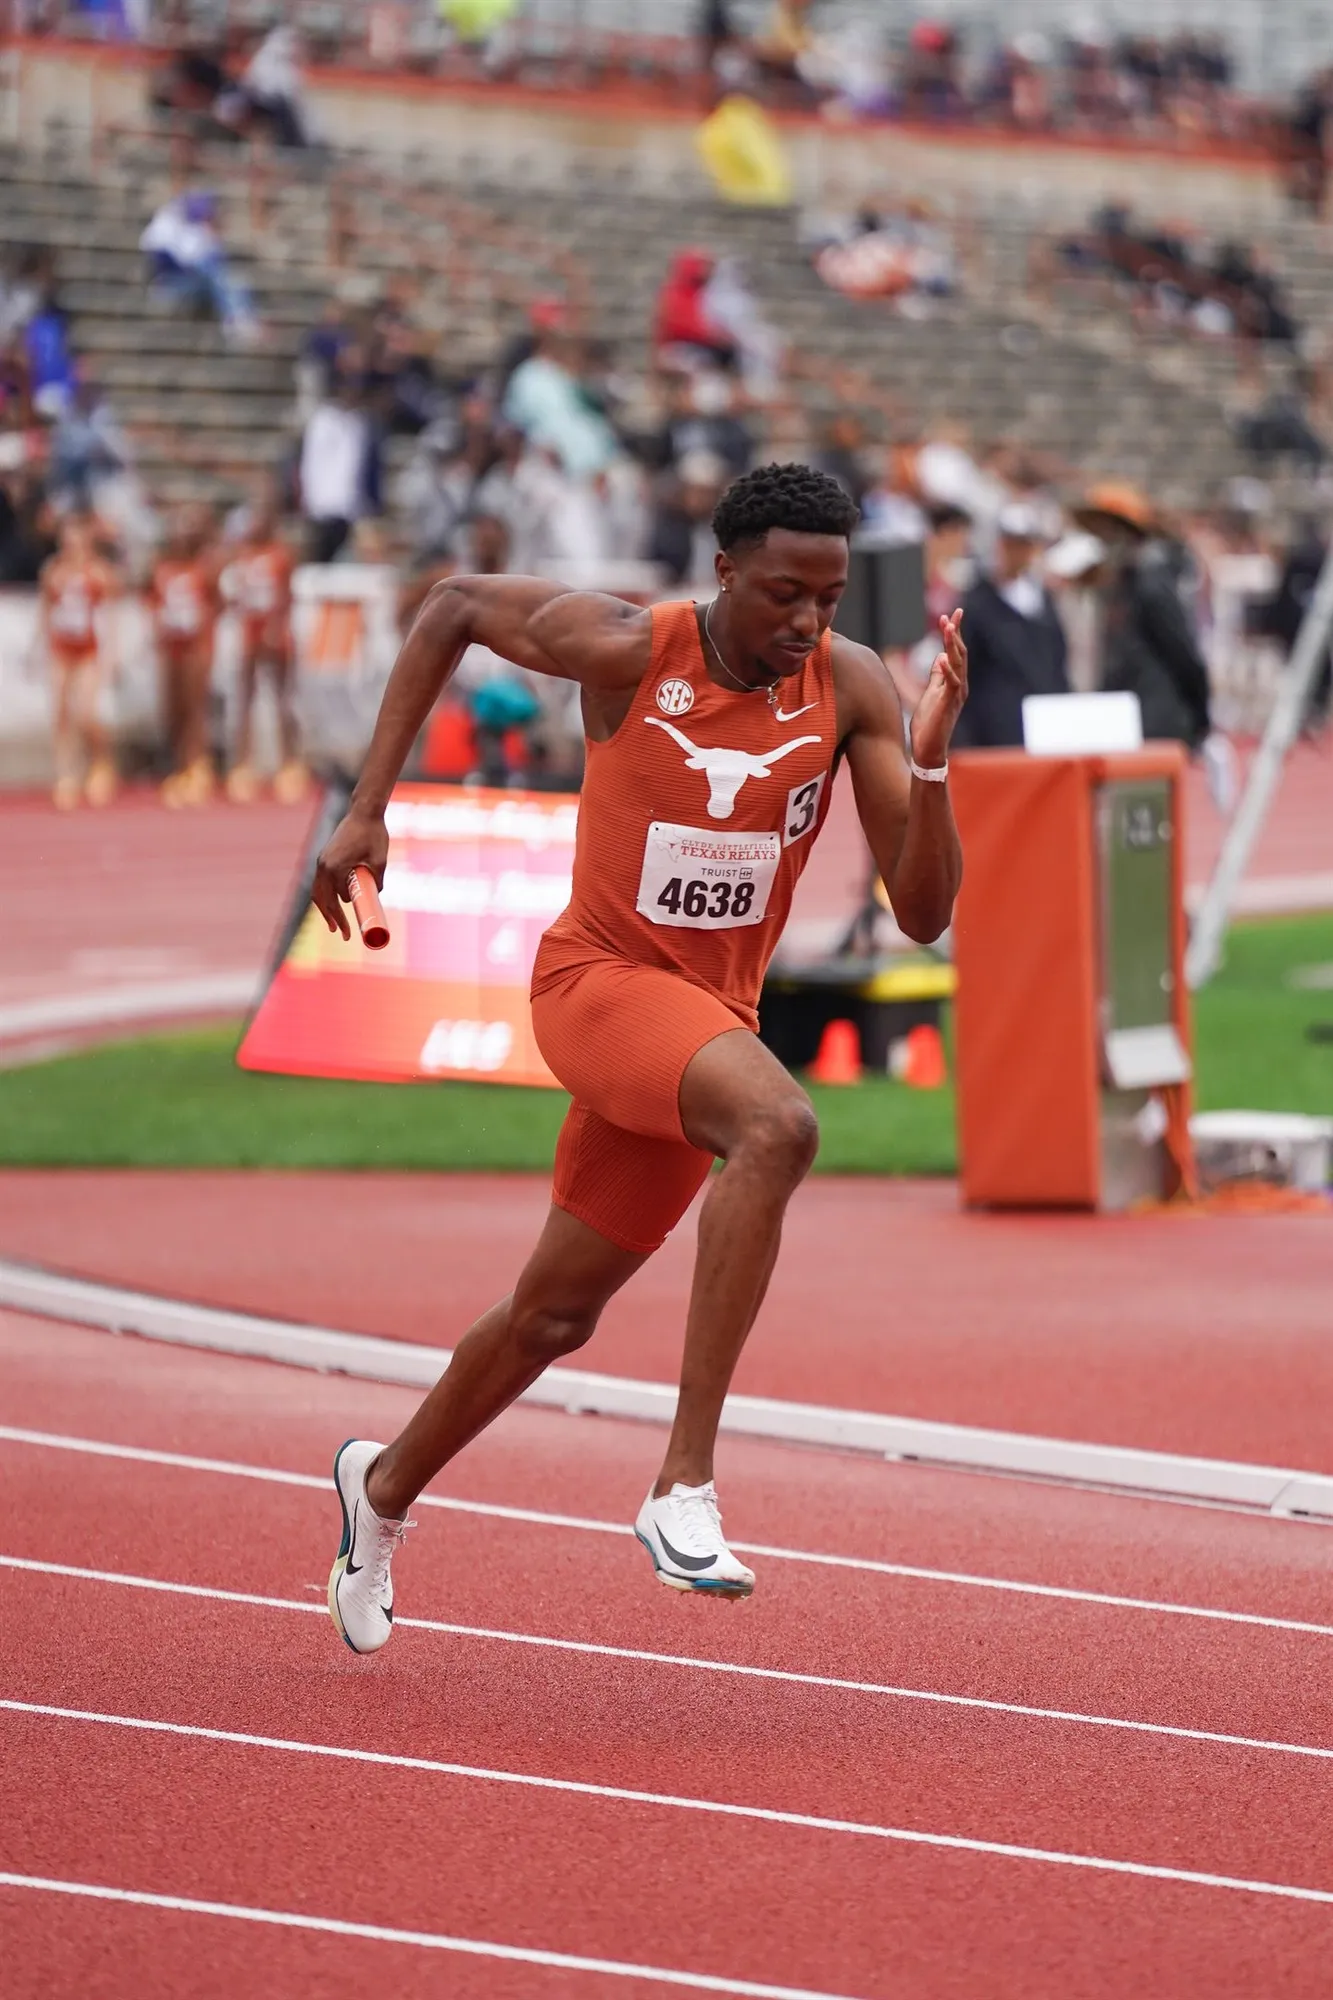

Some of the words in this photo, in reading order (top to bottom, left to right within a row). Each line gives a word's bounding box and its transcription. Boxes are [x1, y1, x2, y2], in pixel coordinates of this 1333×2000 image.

[659, 680, 691, 712] SEC
[789, 782, 818, 837] 3
[680, 846, 726, 860] TEXAS
[728, 850, 776, 861] RELAYS
[681, 839, 713, 850] CLYDE
[701, 867, 738, 877] TRUIST
[657, 877, 755, 918] 4638
